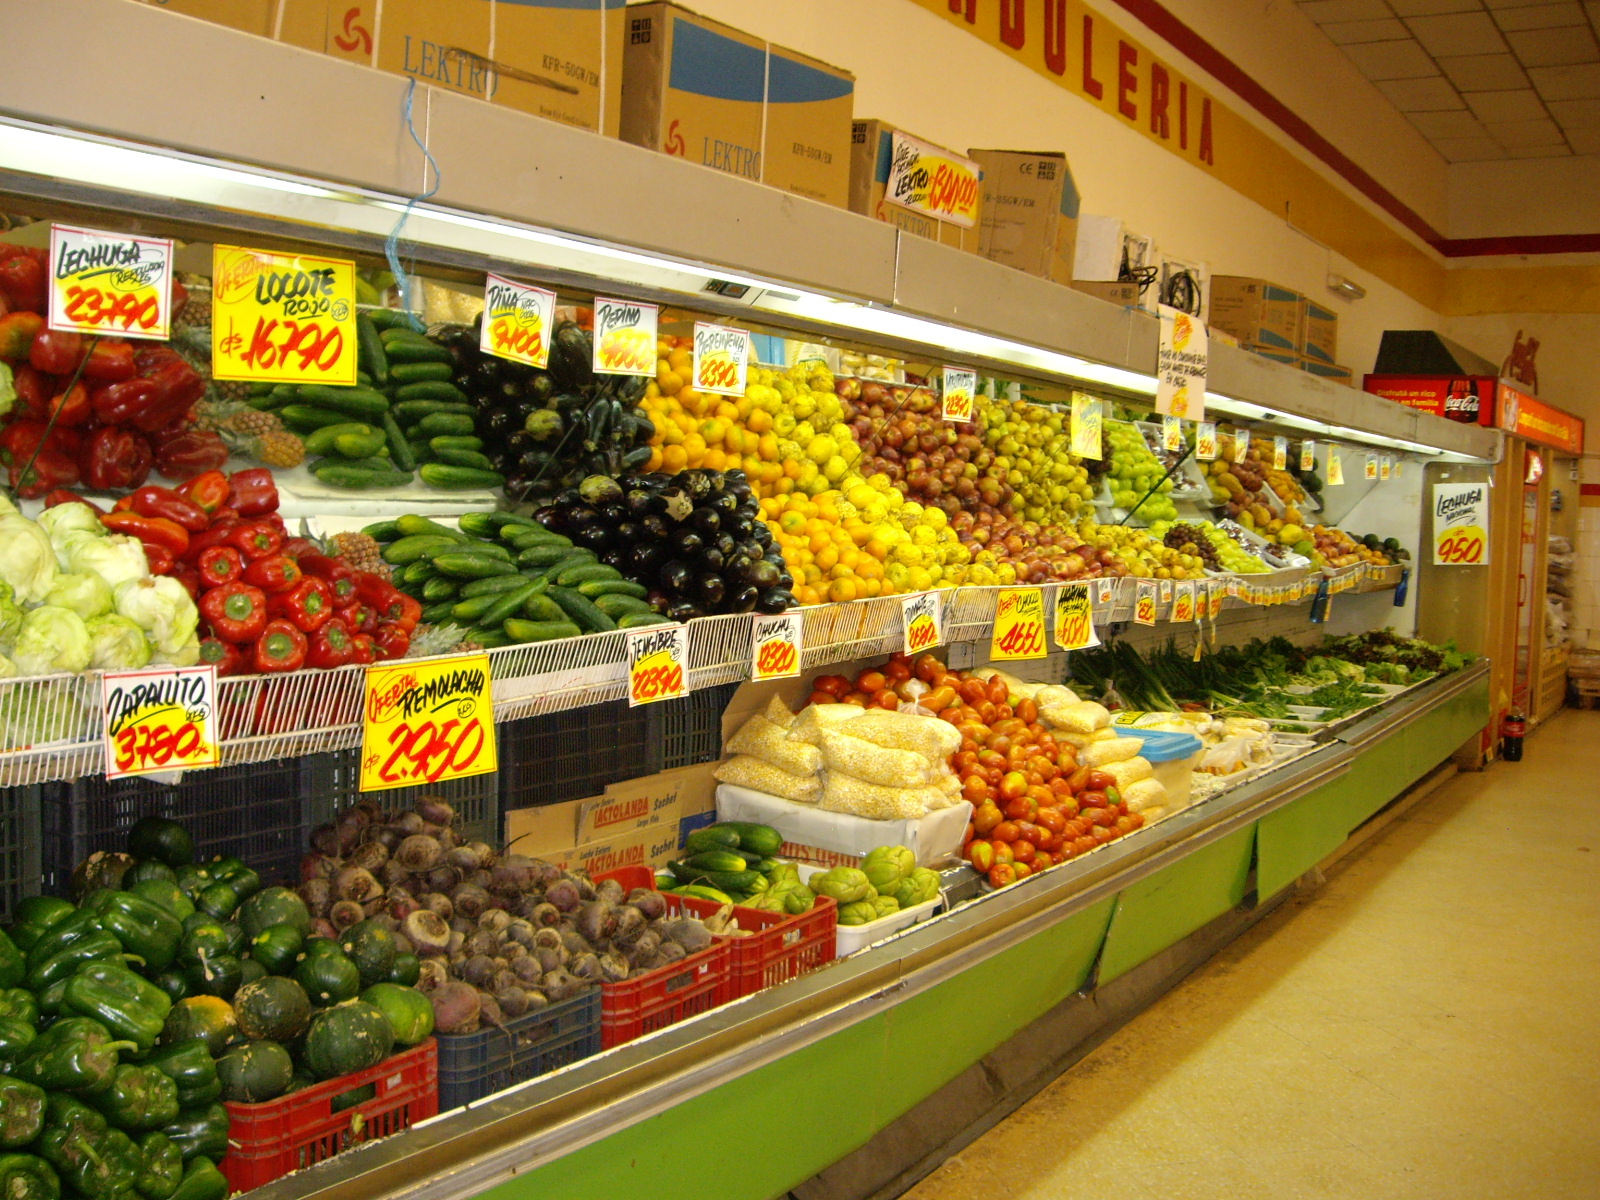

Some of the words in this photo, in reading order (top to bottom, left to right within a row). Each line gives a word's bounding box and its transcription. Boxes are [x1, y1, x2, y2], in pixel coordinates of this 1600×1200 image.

[402, 35, 498, 96] LEKTRO
[948, 0, 1213, 166] DULERIA
[702, 137, 761, 179] LEKTRO
[56, 240, 141, 279] LECHUGA
[255, 268, 336, 305] LOCOTE
[283, 298, 330, 316] ROJO
[1412, 399, 1439, 407] familia
[1436, 488, 1482, 517] LECHUGA
[396, 668, 485, 720] REMOLACHA
[594, 796, 649, 827] LACTOLANDA
[653, 791, 677, 811] Sachet
